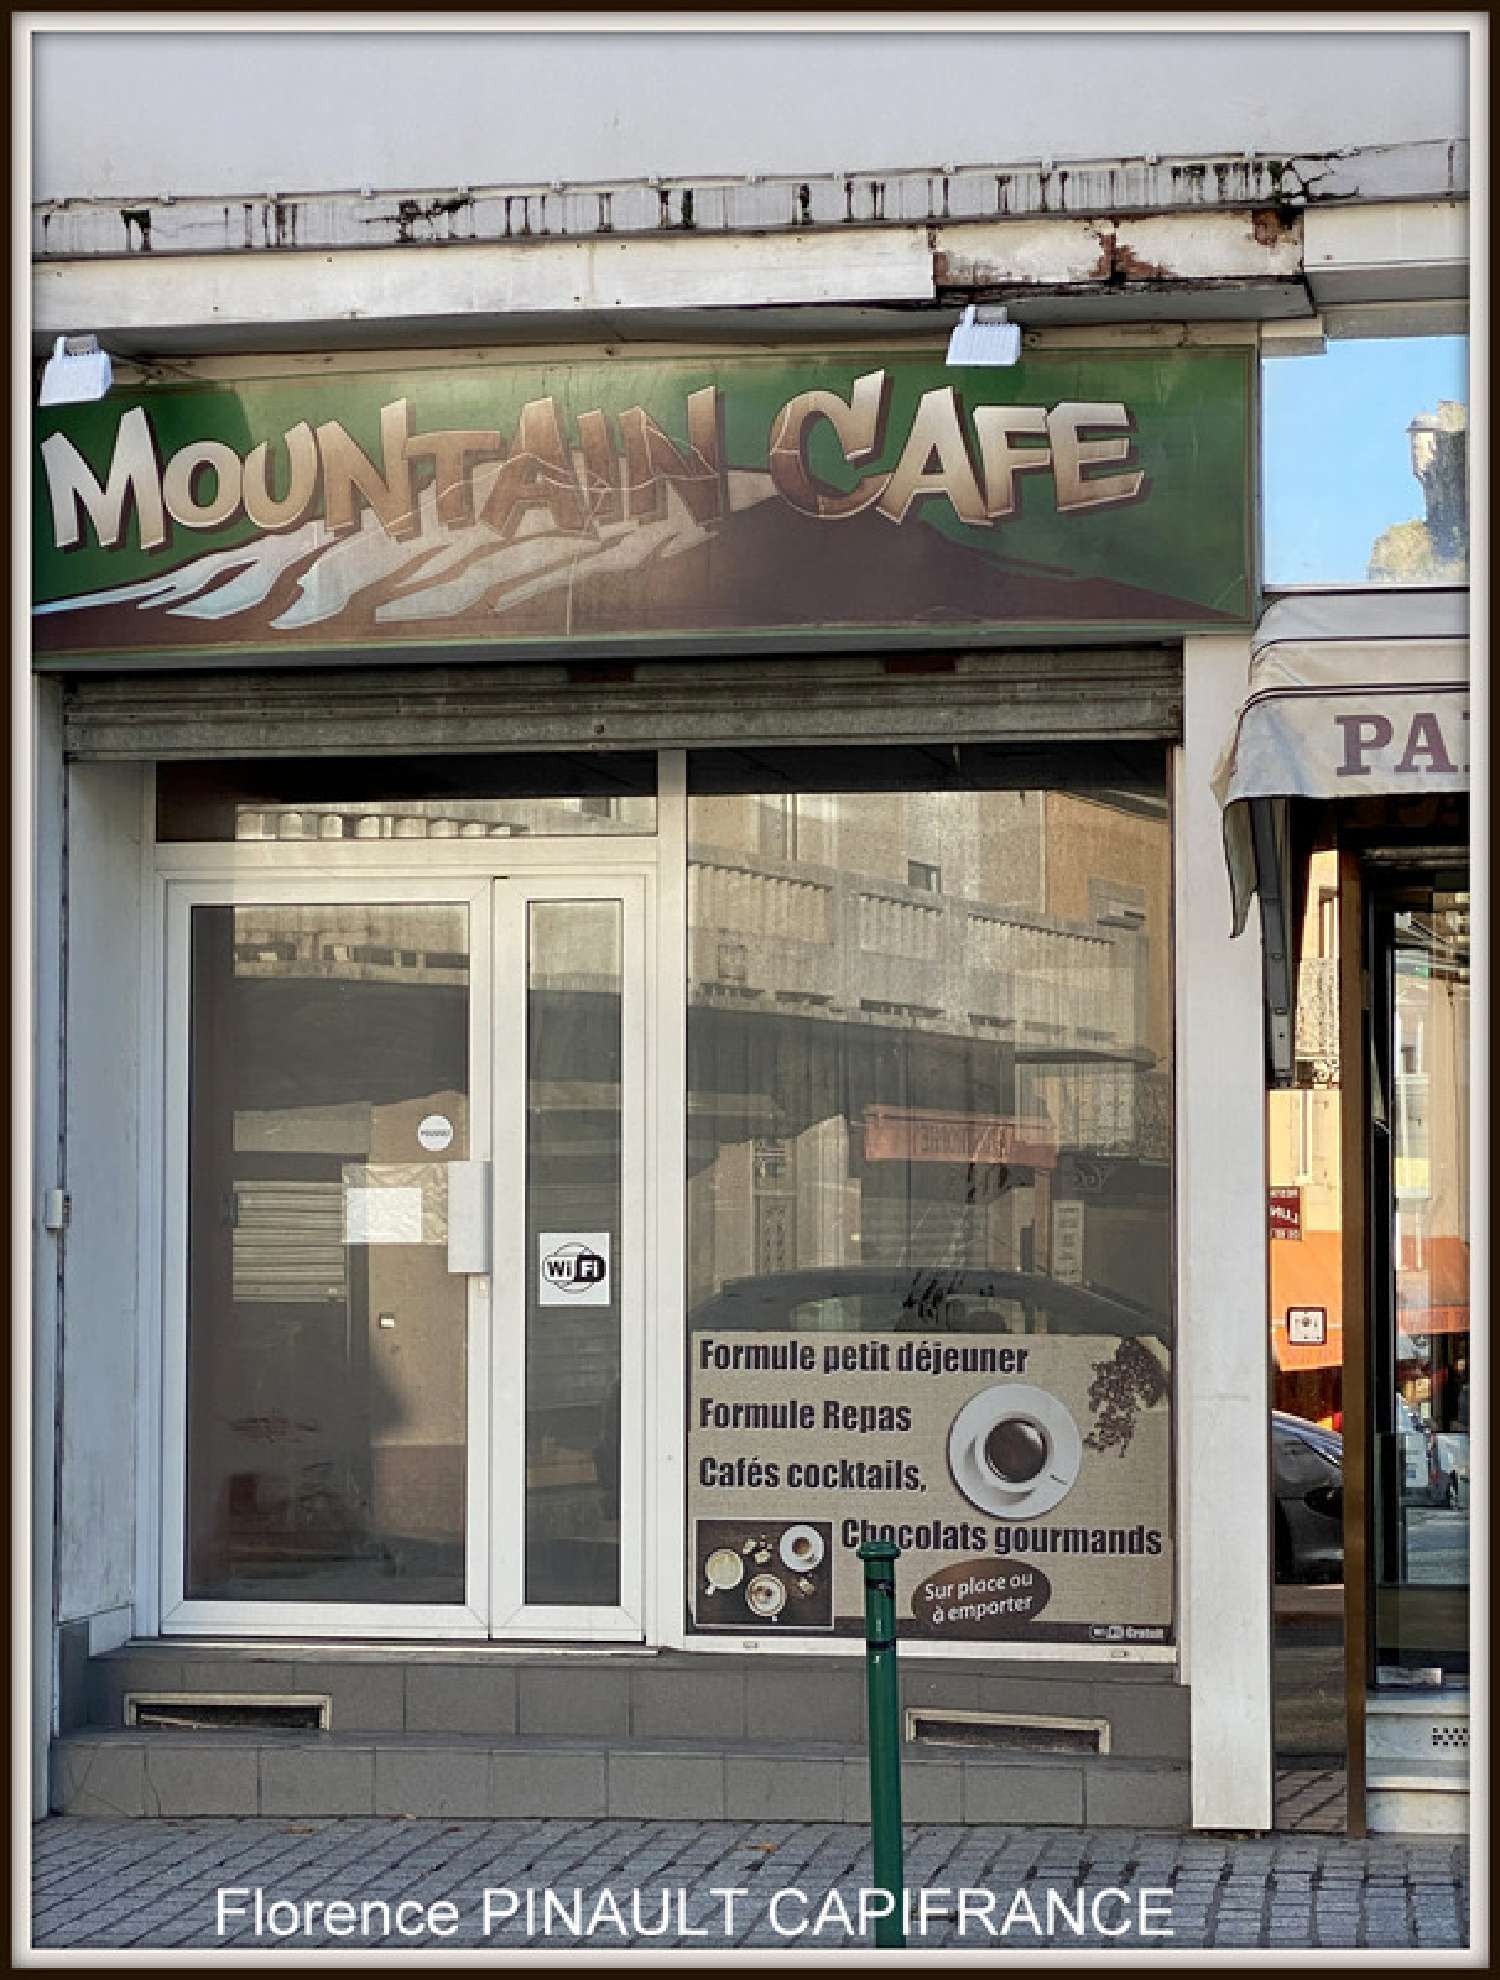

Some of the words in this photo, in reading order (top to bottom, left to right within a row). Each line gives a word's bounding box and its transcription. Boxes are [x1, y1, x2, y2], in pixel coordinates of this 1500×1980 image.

[40, 385, 726, 552] MOUNTAIN
[769, 368, 1148, 526] CAFE
[1335, 710, 1470, 777] PA
[700, 1339, 815, 1370] Formule
[824, 1340, 890, 1375] petit
[898, 1340, 1029, 1375] déjeuner
[700, 1398, 815, 1429] Formule
[824, 1400, 912, 1433] Repas
[699, 1455, 780, 1488] Cafés
[787, 1459, 927, 1494] cocktails,
[842, 1519, 986, 1550] Chocolats
[995, 1525, 1162, 1555] gourmands
[924, 1583, 954, 1601] Sur
[958, 1576, 1006, 1601] place
[1009, 1573, 1033, 1589] ou
[932, 1603, 944, 1625] à
[947, 1595, 1033, 1622] emporter
